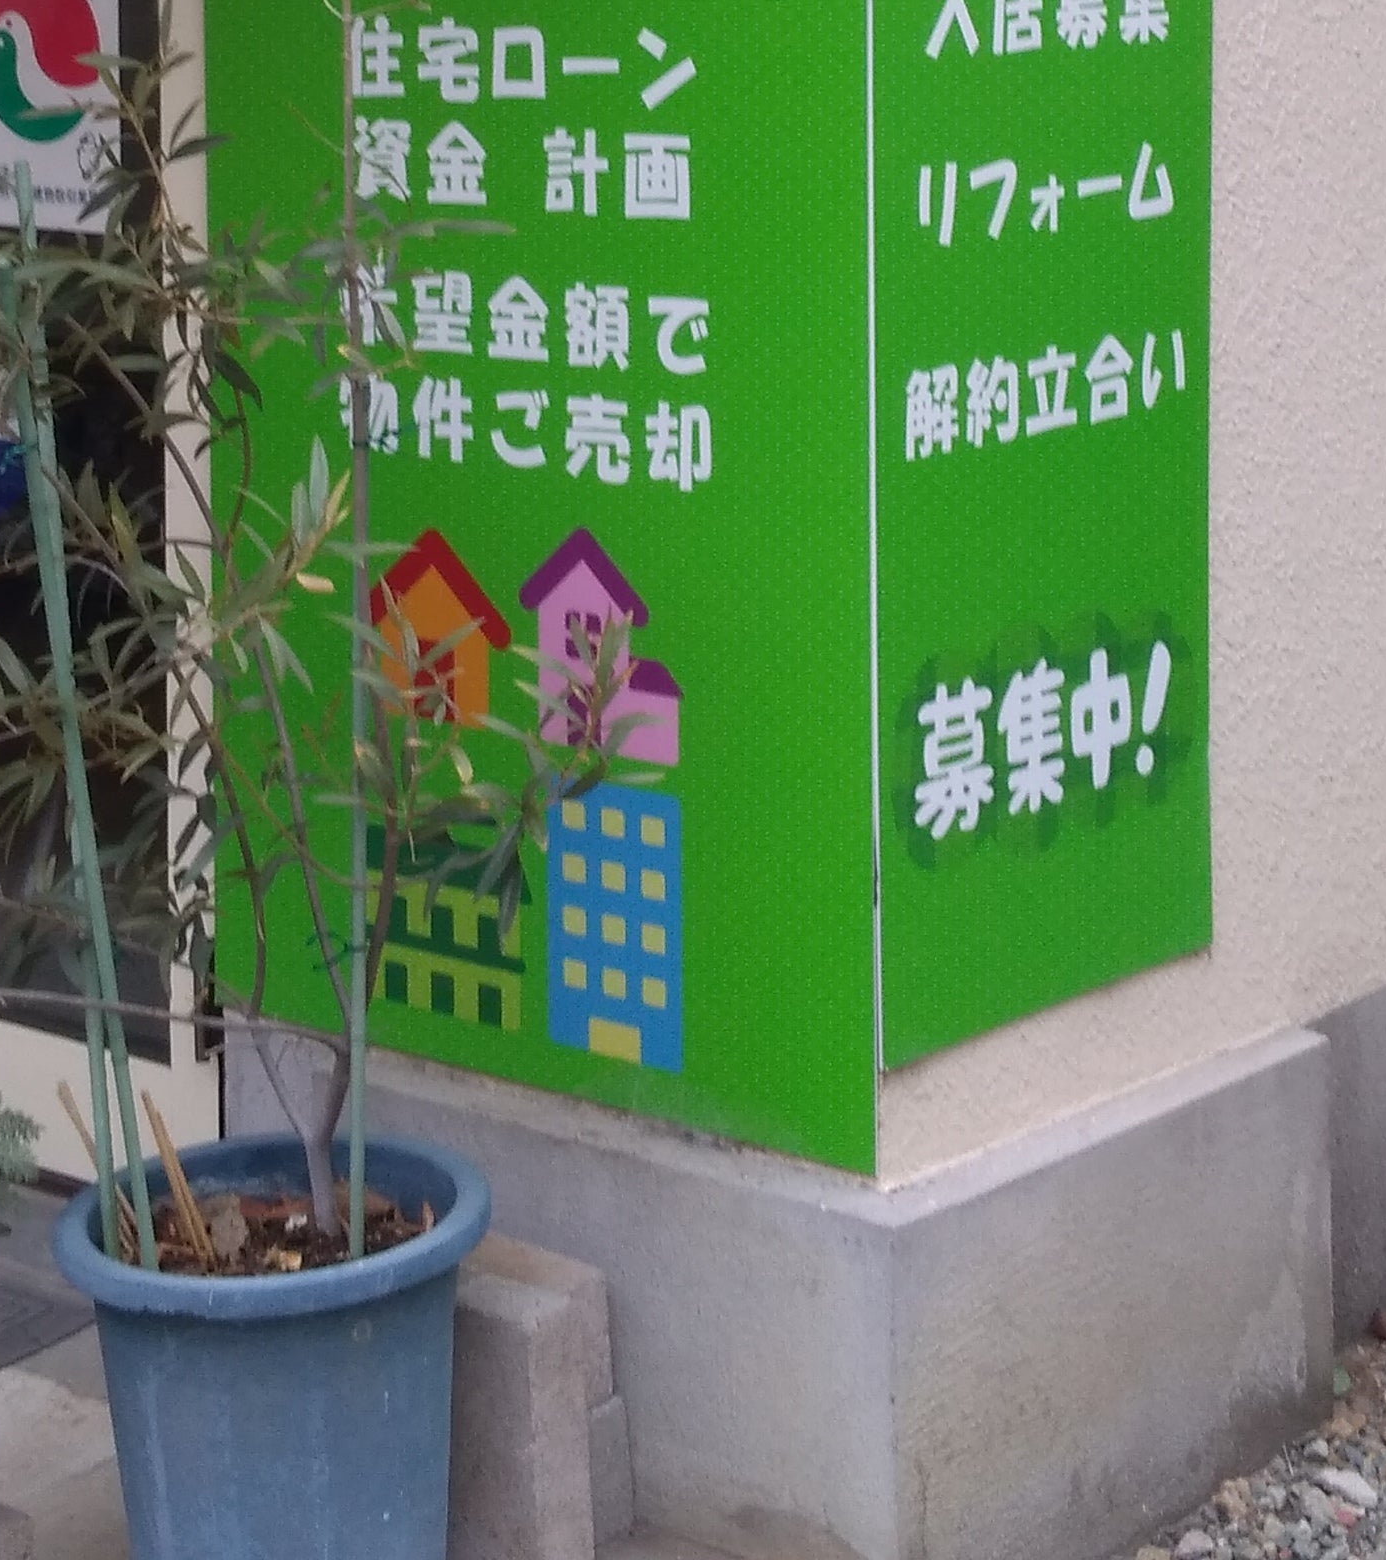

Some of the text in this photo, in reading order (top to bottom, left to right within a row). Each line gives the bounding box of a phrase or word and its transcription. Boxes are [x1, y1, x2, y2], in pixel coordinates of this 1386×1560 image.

[348, 14, 697, 111] 住宅ローン
[352, 116, 692, 221] 資金 計画
[918, 141, 1174, 247] リフォーム
[339, 372, 713, 493] 物件ご売却
[905, 329, 1186, 462] 解約立合い
